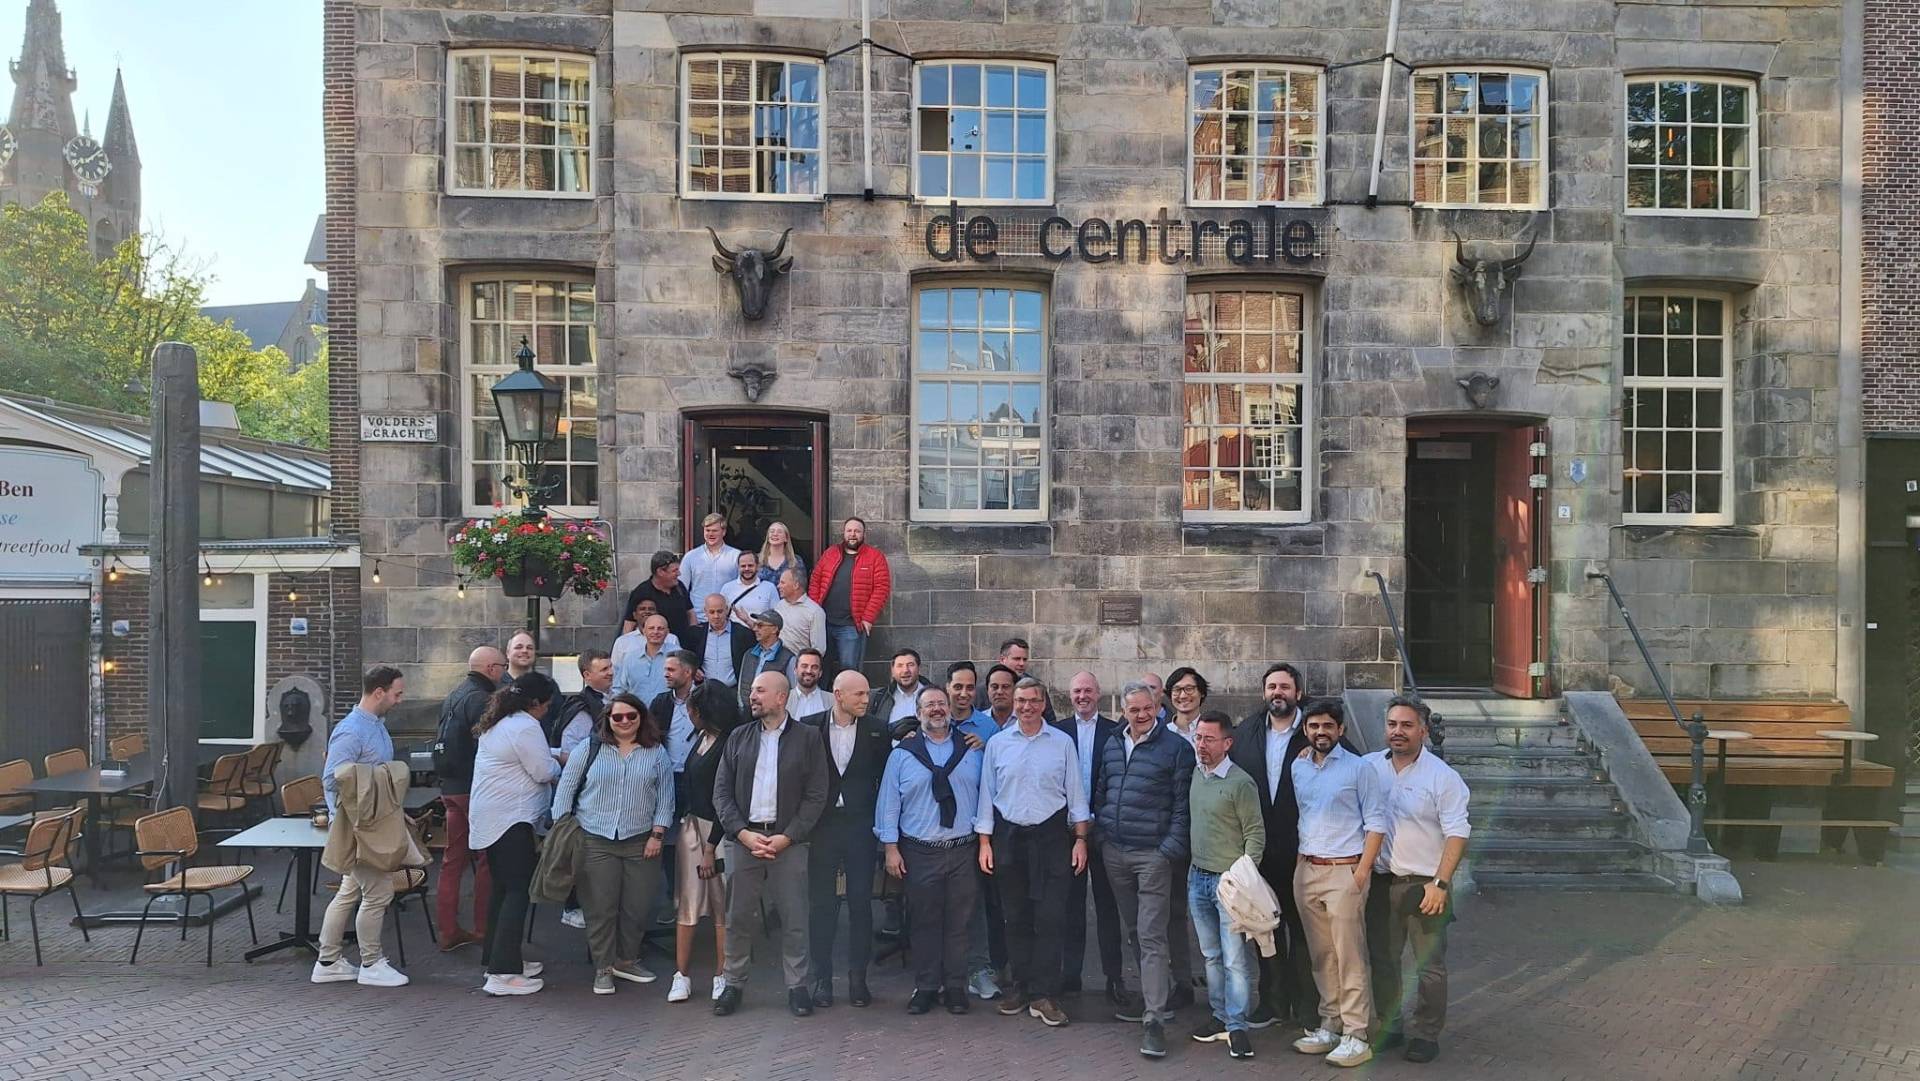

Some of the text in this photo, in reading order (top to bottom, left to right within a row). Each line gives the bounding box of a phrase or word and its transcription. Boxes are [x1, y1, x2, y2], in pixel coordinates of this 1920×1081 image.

[925, 200, 1316, 265] de centrale
[373, 429, 424, 438] GRACHT
[0, 480, 33, 497] Ben
